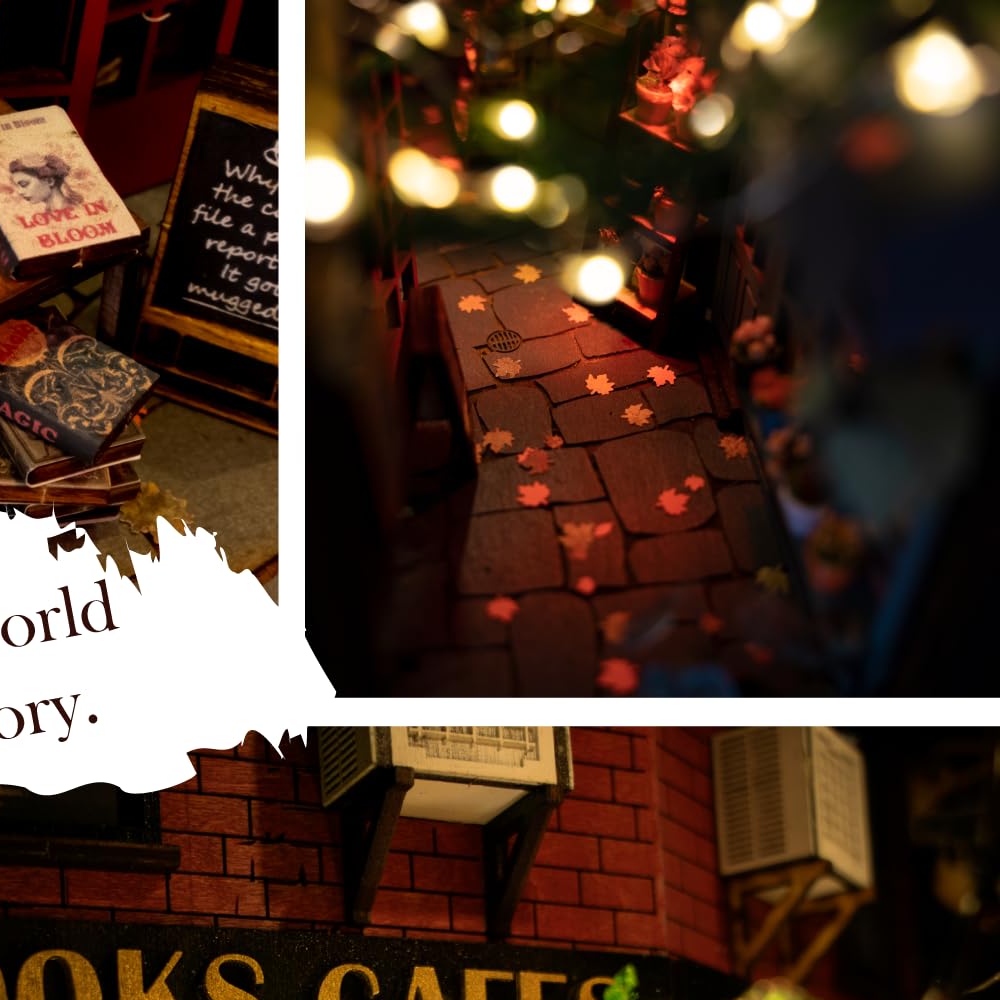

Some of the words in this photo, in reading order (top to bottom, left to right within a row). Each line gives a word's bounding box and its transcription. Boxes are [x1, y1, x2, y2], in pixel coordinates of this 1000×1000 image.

[212, 183, 254, 209] the
[16, 207, 78, 230] LOVE
[85, 200, 109, 218] IN
[192, 204, 233, 225] file
[240, 222, 256, 237] a
[38, 220, 119, 249] BLOOM
[221, 263, 243, 283] It
